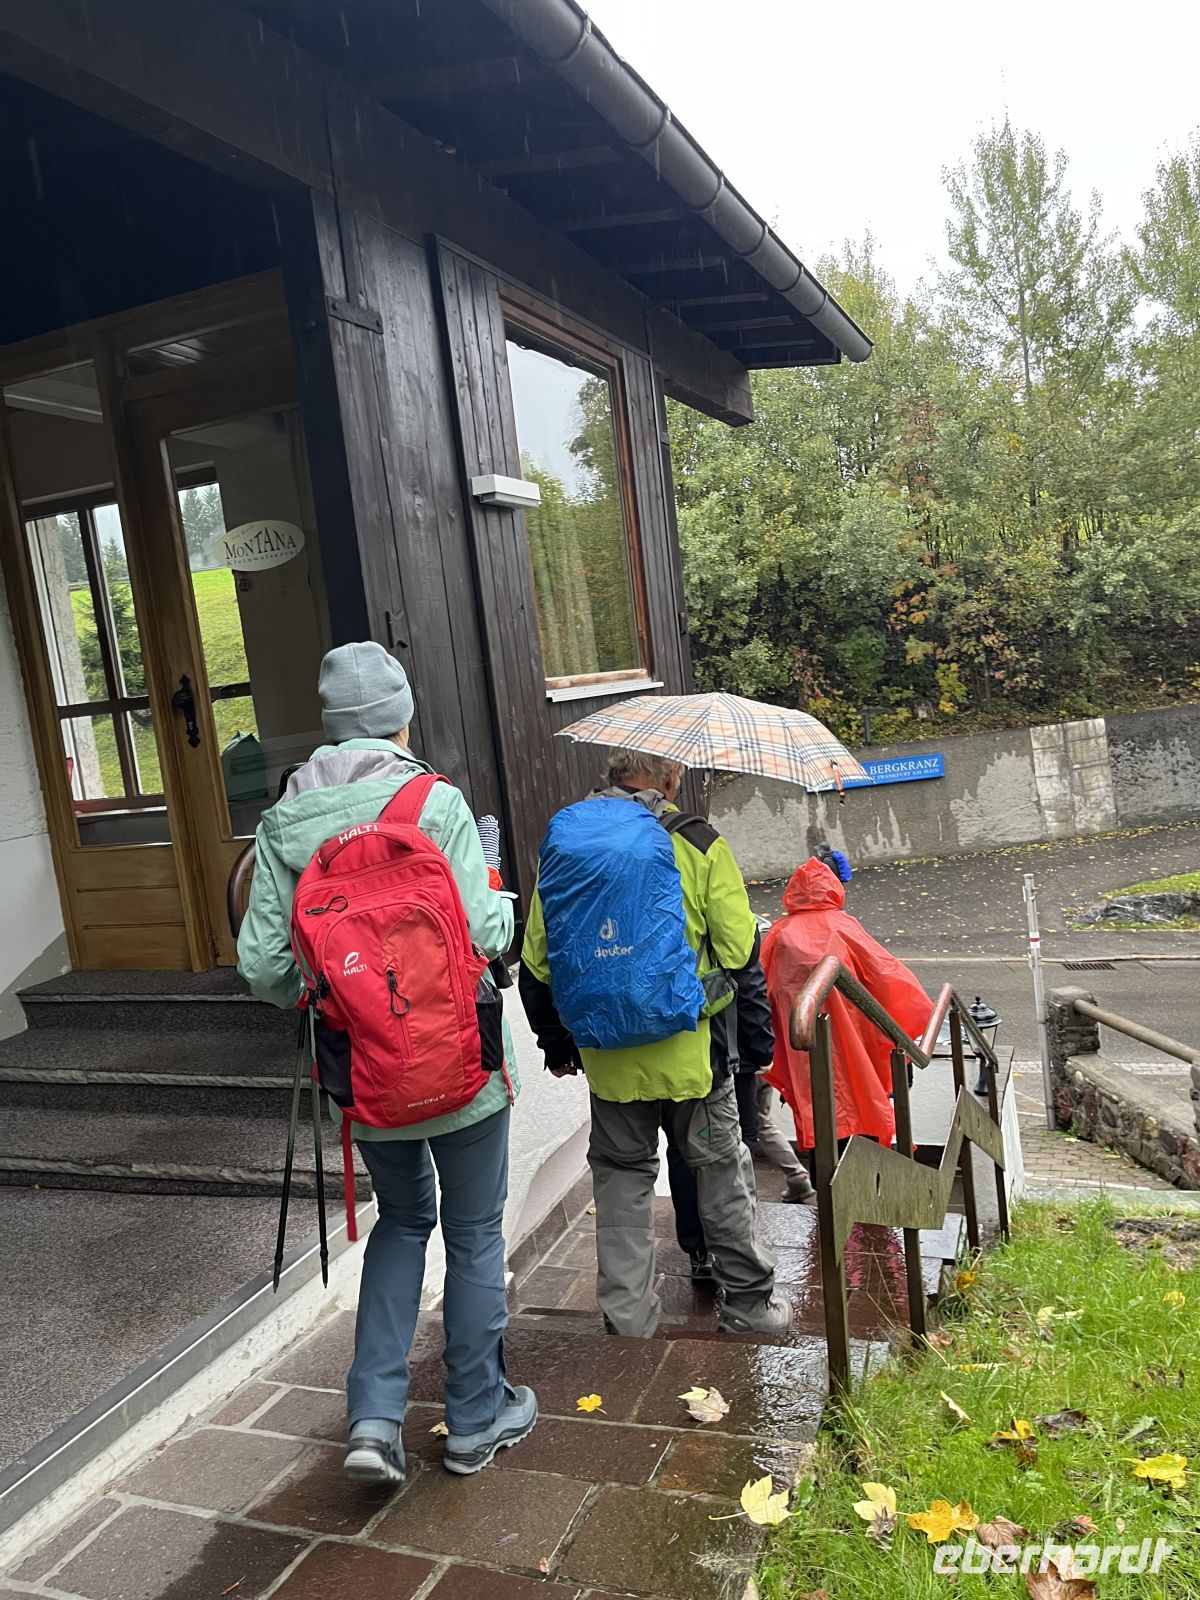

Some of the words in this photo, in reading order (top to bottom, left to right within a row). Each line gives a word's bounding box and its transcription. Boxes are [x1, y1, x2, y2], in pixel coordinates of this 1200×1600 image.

[869, 758, 940, 775] BERGKRANZ
[877, 771, 911, 780] FRANKFURT
[338, 824, 378, 845] HALTI
[594, 944, 634, 958] deuter
[343, 963, 368, 977] HALTI
